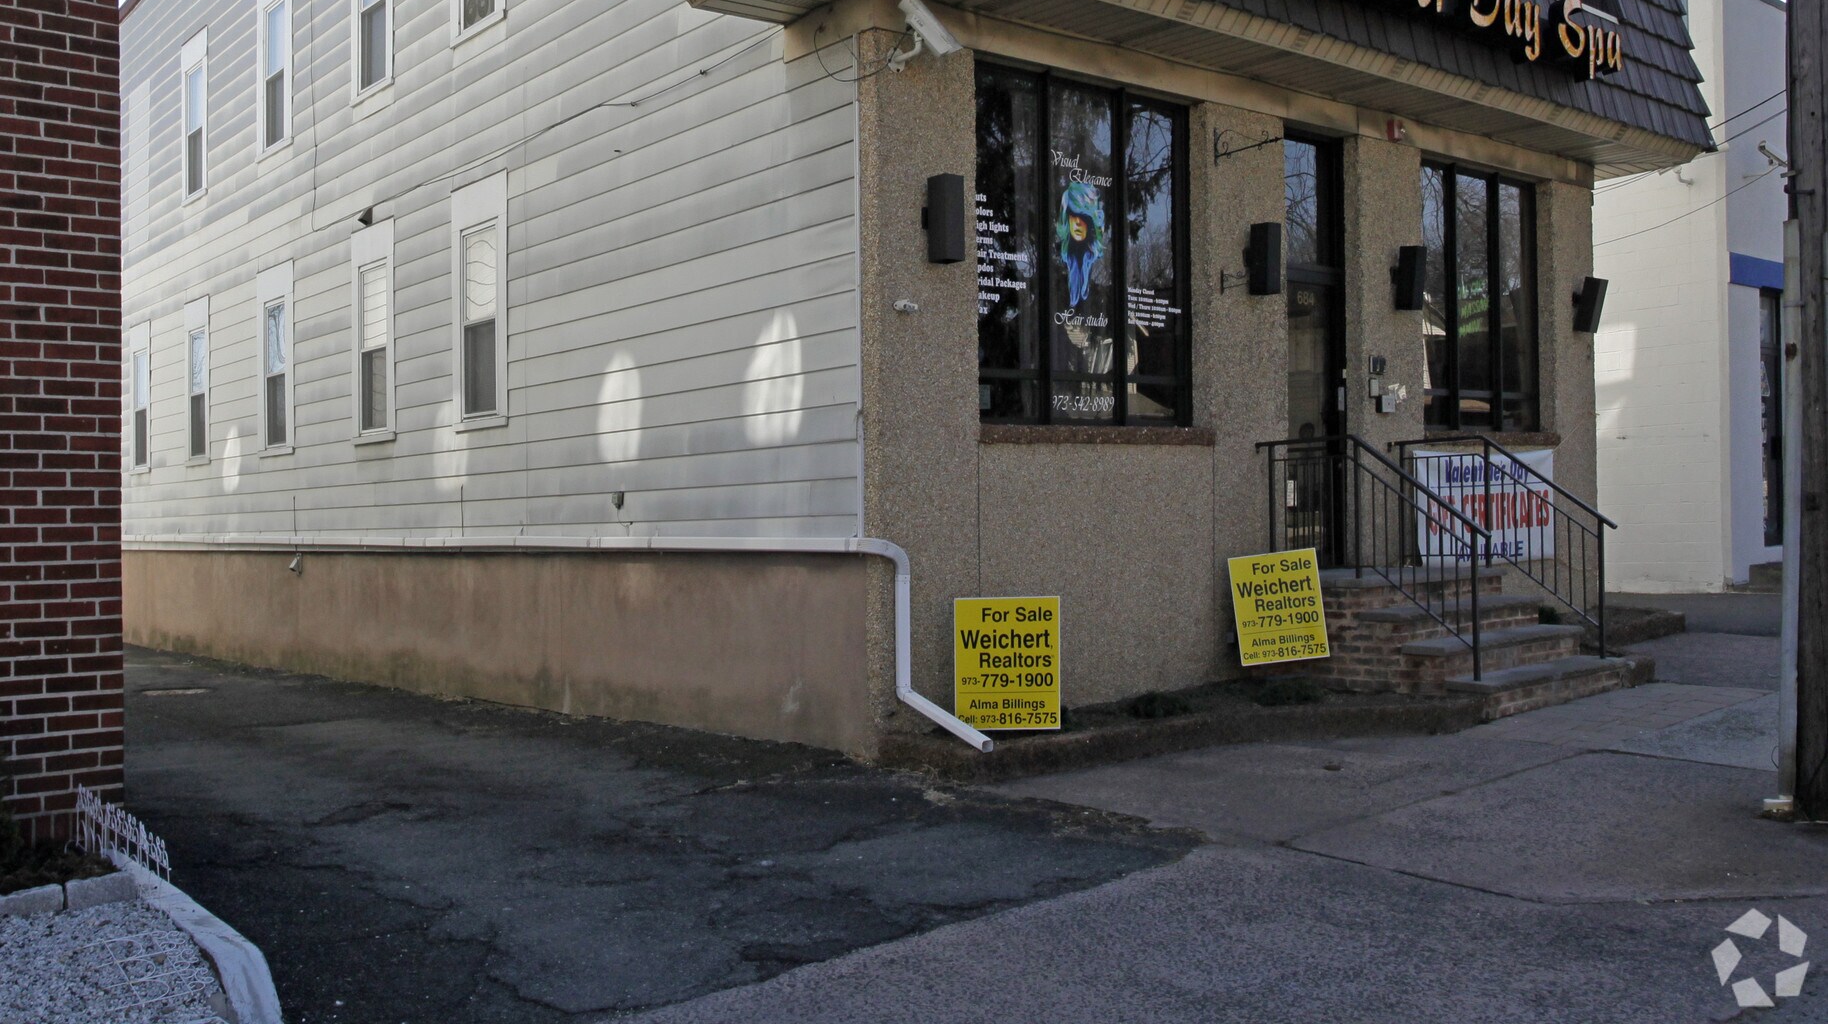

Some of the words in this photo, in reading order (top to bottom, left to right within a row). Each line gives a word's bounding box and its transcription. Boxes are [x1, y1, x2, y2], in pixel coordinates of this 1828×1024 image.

[1051, 149, 1080, 168] Visual
[1069, 168, 1112, 187] Elegance
[975, 193, 987, 202] uts
[975, 206, 993, 217] olors
[976, 220, 987, 232] igh
[989, 221, 1009, 233] lights
[976, 236, 993, 244] erms
[977, 249, 987, 258] air
[988, 249, 1028, 262] Treatments
[977, 262, 994, 273] pdos
[978, 276, 994, 286] ridal
[995, 277, 1026, 291] Packages
[978, 290, 1000, 303] akeup
[1297, 291, 1314, 306] 684
[1054, 308, 1084, 326] Hair
[1085, 313, 1108, 327] studio
[1053, 395, 1115, 412] 973-542-8989
[1252, 562, 1276, 576] For
[1280, 558, 1312, 572] Sale
[1255, 595, 1316, 612] Realtors
[981, 607, 1010, 623] For
[1015, 606, 1053, 622] Sale
[1251, 638, 1276, 647] Alma
[1279, 634, 1315, 644] Billings
[1243, 651, 1260, 660] Cell:
[1262, 643, 1327, 658] 973-816-7575
[979, 652, 1053, 669] Realtors
[969, 699, 999, 710] Alma
[1002, 698, 1046, 711] Billings
[957, 714, 978, 724] Cell:
[980, 712, 1058, 725] 973-816-7575
